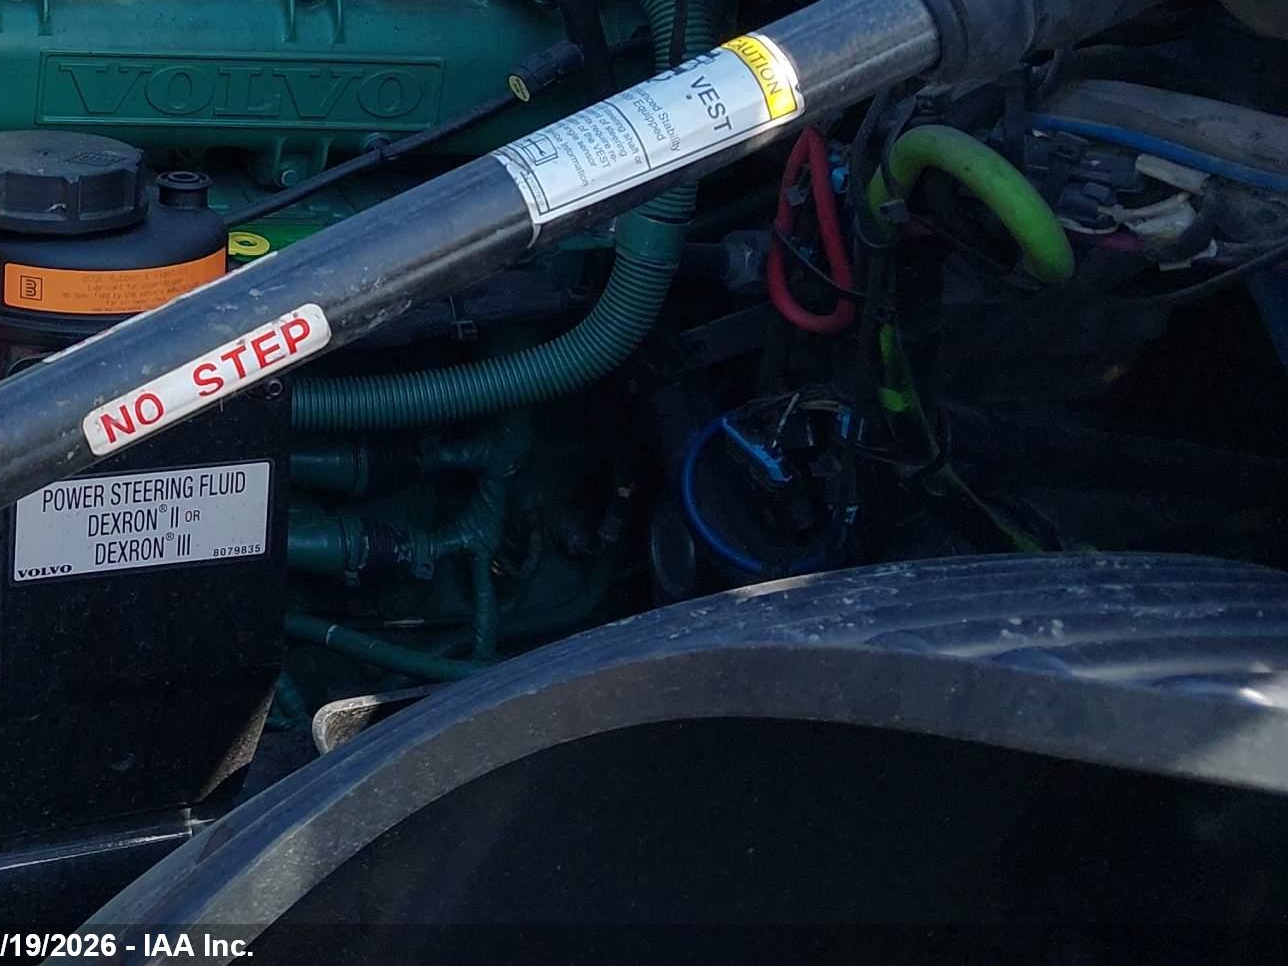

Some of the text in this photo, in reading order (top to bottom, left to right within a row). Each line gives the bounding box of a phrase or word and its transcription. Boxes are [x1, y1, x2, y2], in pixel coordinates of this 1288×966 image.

[727, 37, 784, 96] CAUTION
[59, 62, 426, 119] VOLVO
[689, 75, 734, 133] VEST
[633, 98, 666, 142] Equipped
[658, 112, 681, 152] Stability
[593, 145, 610, 168] VEST
[99, 316, 312, 444] NO STEP
[42, 471, 247, 513] POWER STEERING FLUID
[170, 506, 179, 529] II
[185, 510, 201, 523] OR
[17, 544, 262, 579] VOLVO 8079835
[177, 534, 191, 557] III
